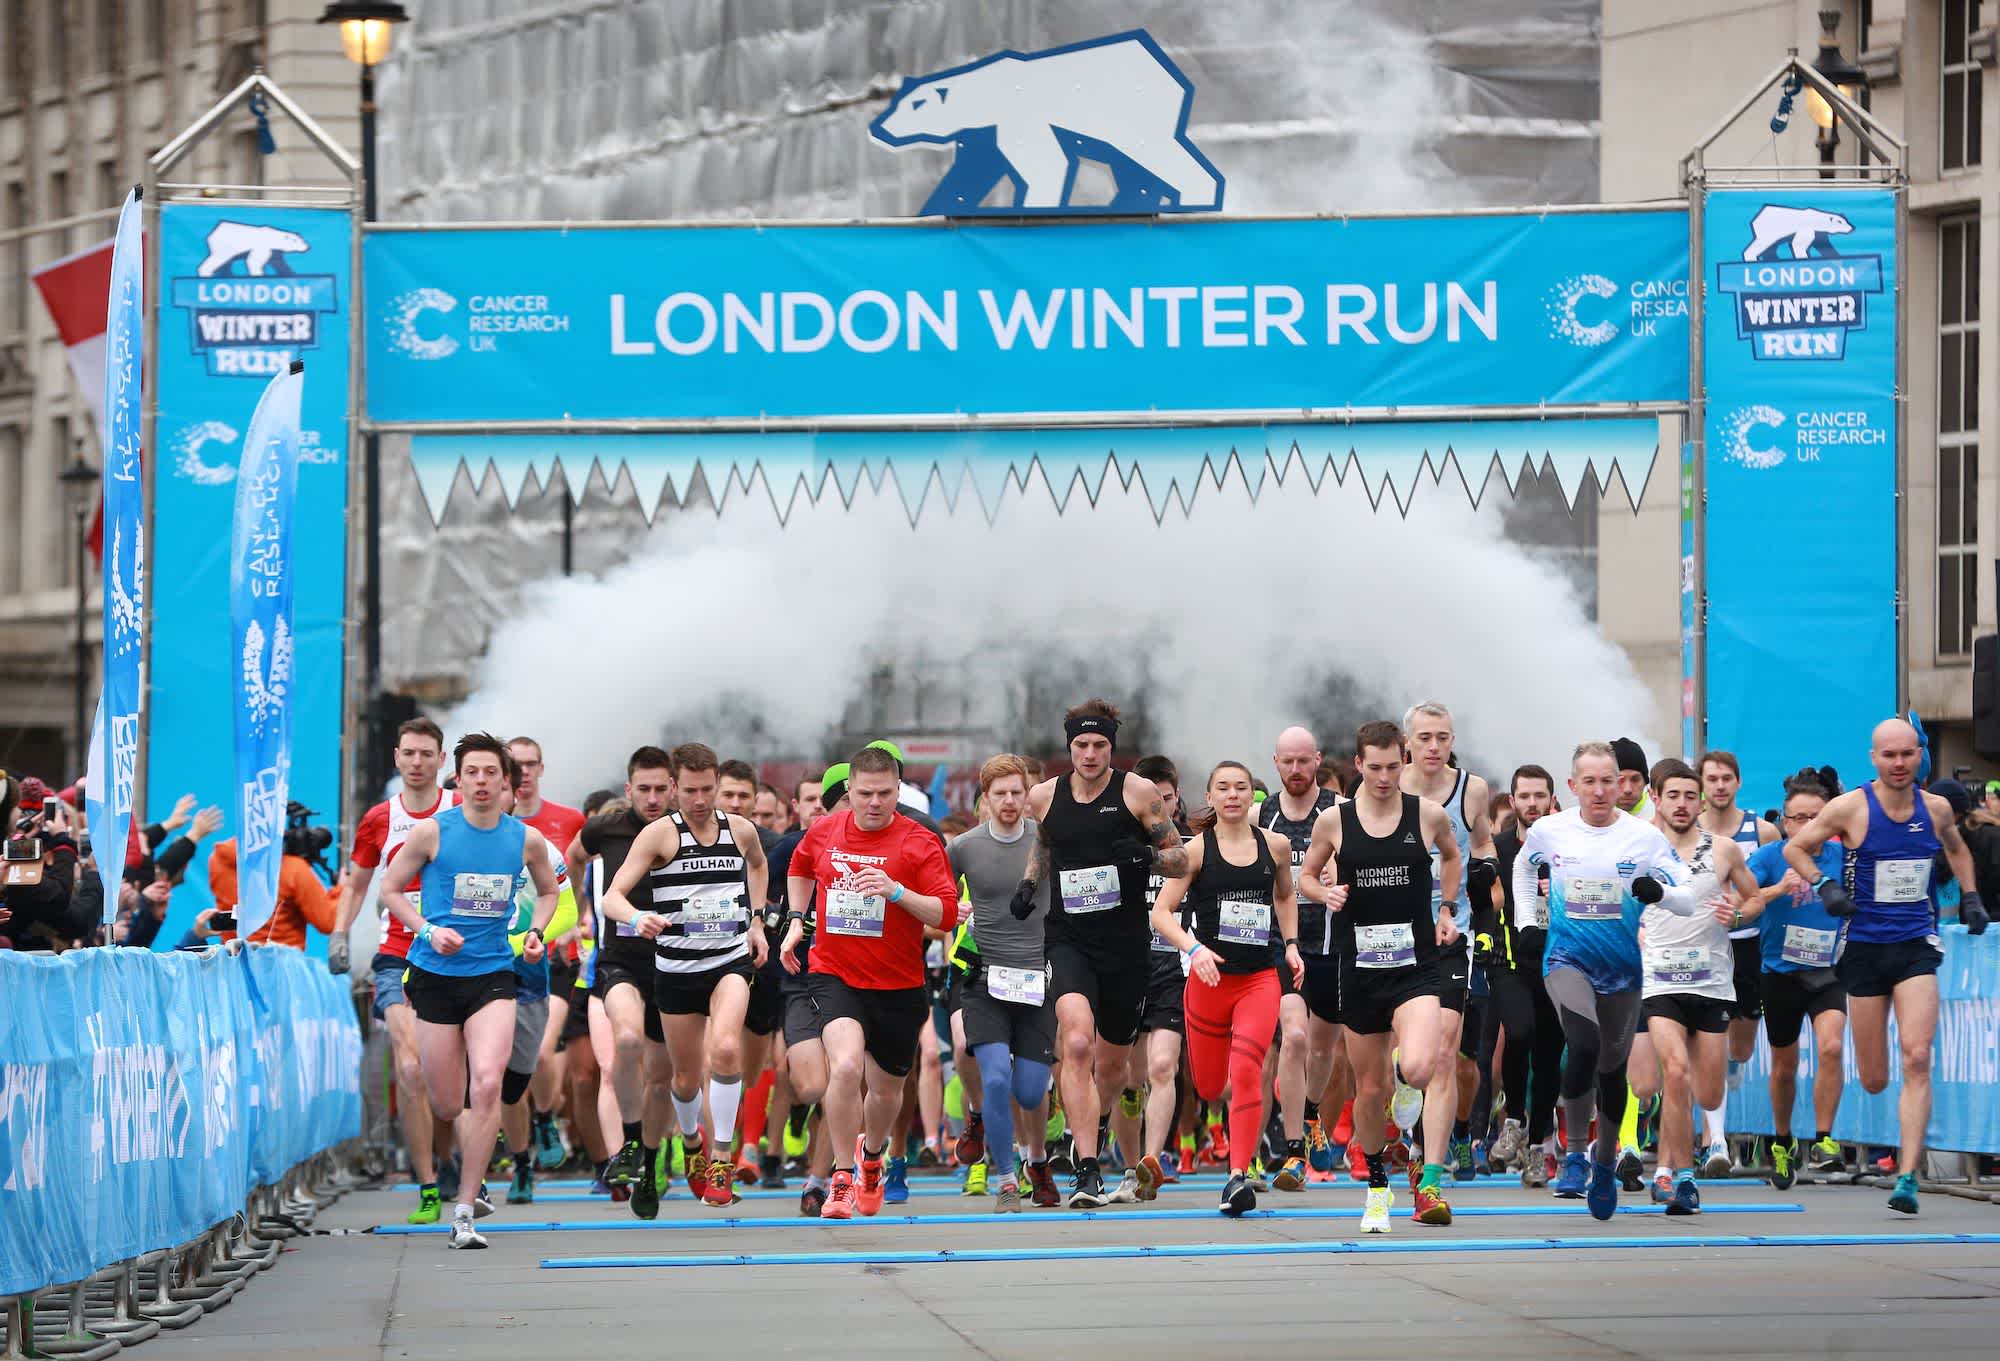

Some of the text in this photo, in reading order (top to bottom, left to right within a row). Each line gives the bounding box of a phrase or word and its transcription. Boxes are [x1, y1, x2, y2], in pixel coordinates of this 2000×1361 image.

[1744, 267, 1855, 286] LONDON
[198, 283, 311, 304] LONDON
[1630, 280, 1689, 298] CANC
[468, 295, 549, 312] CANCER
[1631, 300, 1689, 317] RESEA
[1744, 294, 1856, 326] WINTER
[469, 315, 570, 332] RESEARCH
[609, 281, 1498, 355] LONDON WINTER RUN
[198, 313, 312, 342] WINTER
[1631, 319, 1657, 337] UK
[469, 335, 497, 352] UK
[1763, 332, 1837, 356] RUN
[215, 350, 292, 374] RUN
[1796, 411, 1867, 427] CANCER
[1797, 429, 1886, 445] RESEARCH
[1797, 446, 1821, 462] UK
[682, 859, 736, 871] FULHAM
[1356, 866, 1409, 879] MIDNIGHT
[1357, 876, 1410, 888] RUNNERS
[1082, 895, 1100, 906] 186
[1217, 890, 1266, 900] MIDNIGHT
[472, 901, 492, 910] 303
[703, 923, 721, 932] 324
[844, 920, 861, 929] 374
[1239, 928, 1255, 938] 974
[1671, 973, 1693, 981] 600
